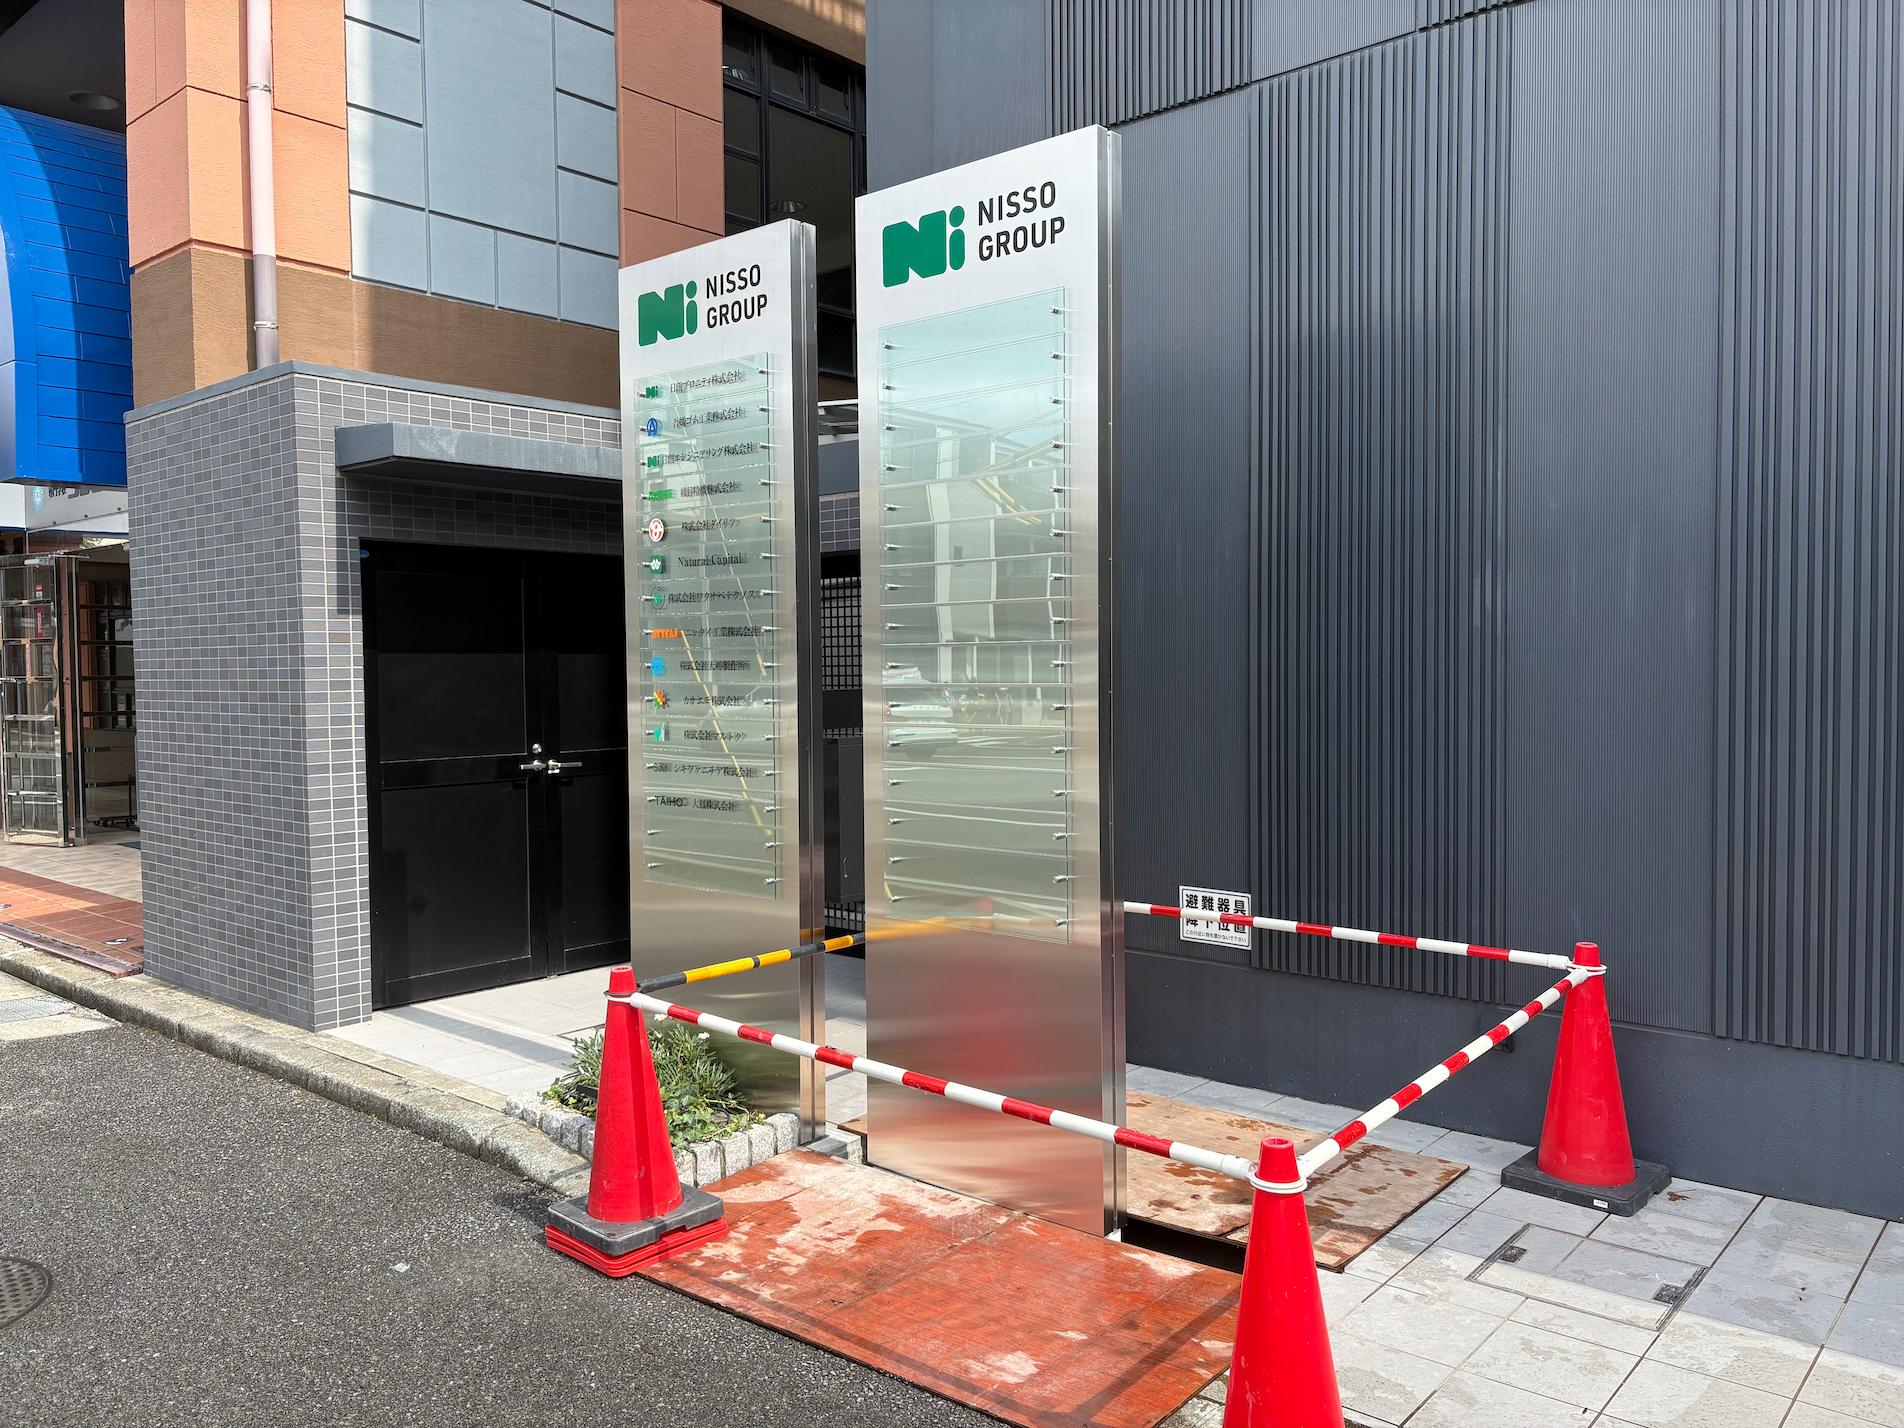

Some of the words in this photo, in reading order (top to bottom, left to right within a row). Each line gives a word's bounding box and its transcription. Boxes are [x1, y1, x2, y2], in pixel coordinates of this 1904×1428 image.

[978, 181, 1056, 226] NISSO
[979, 216, 1065, 262] GROUP
[706, 264, 761, 299] NISSO
[706, 293, 768, 329] GROUP
[678, 556, 709, 568] Natural
[711, 552, 741, 567] Capital
[655, 795, 684, 808] TAIHO
[1185, 893, 1247, 916] 避難器具
